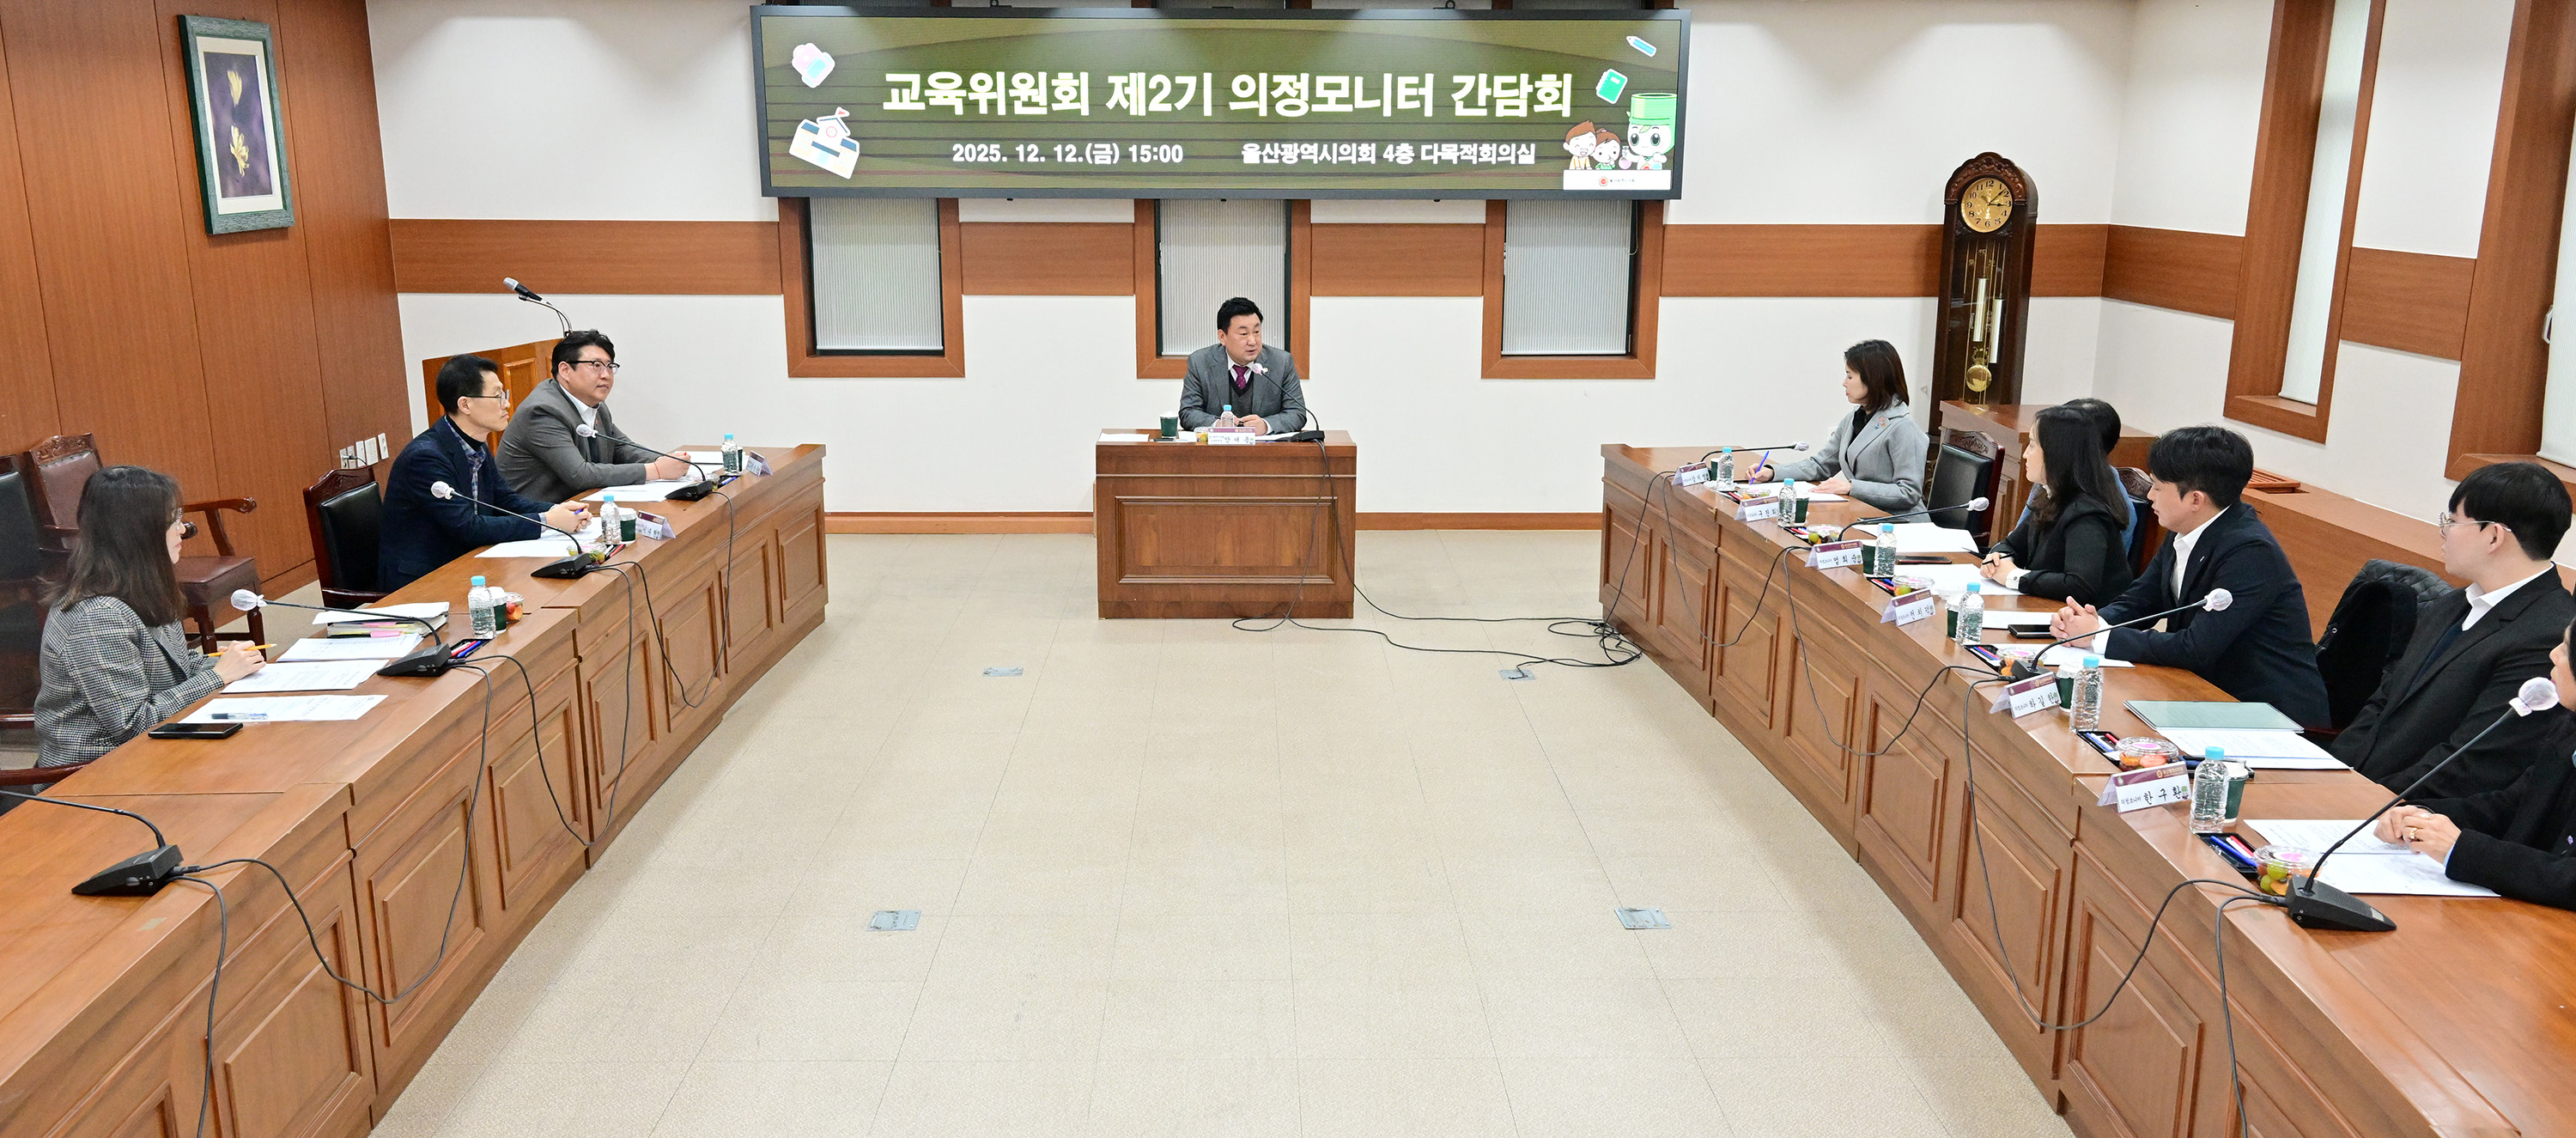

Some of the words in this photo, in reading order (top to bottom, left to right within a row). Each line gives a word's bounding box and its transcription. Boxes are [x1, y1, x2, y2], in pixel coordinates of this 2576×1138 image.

[883, 71, 1090, 116] 교육위원회
[1105, 72, 1212, 117] 제2기
[1229, 72, 1435, 117] 의정모니터
[1451, 73, 1572, 118] 간담회
[952, 143, 1007, 162] 2025.
[1015, 143, 1046, 162] 12.
[1053, 143, 1120, 165] 12.(금)
[1128, 144, 1183, 163] 15:00
[1241, 143, 1376, 165] 울산광역시의회
[1382, 143, 1415, 165] 4층
[1420, 143, 1536, 165] 다목적회의실
